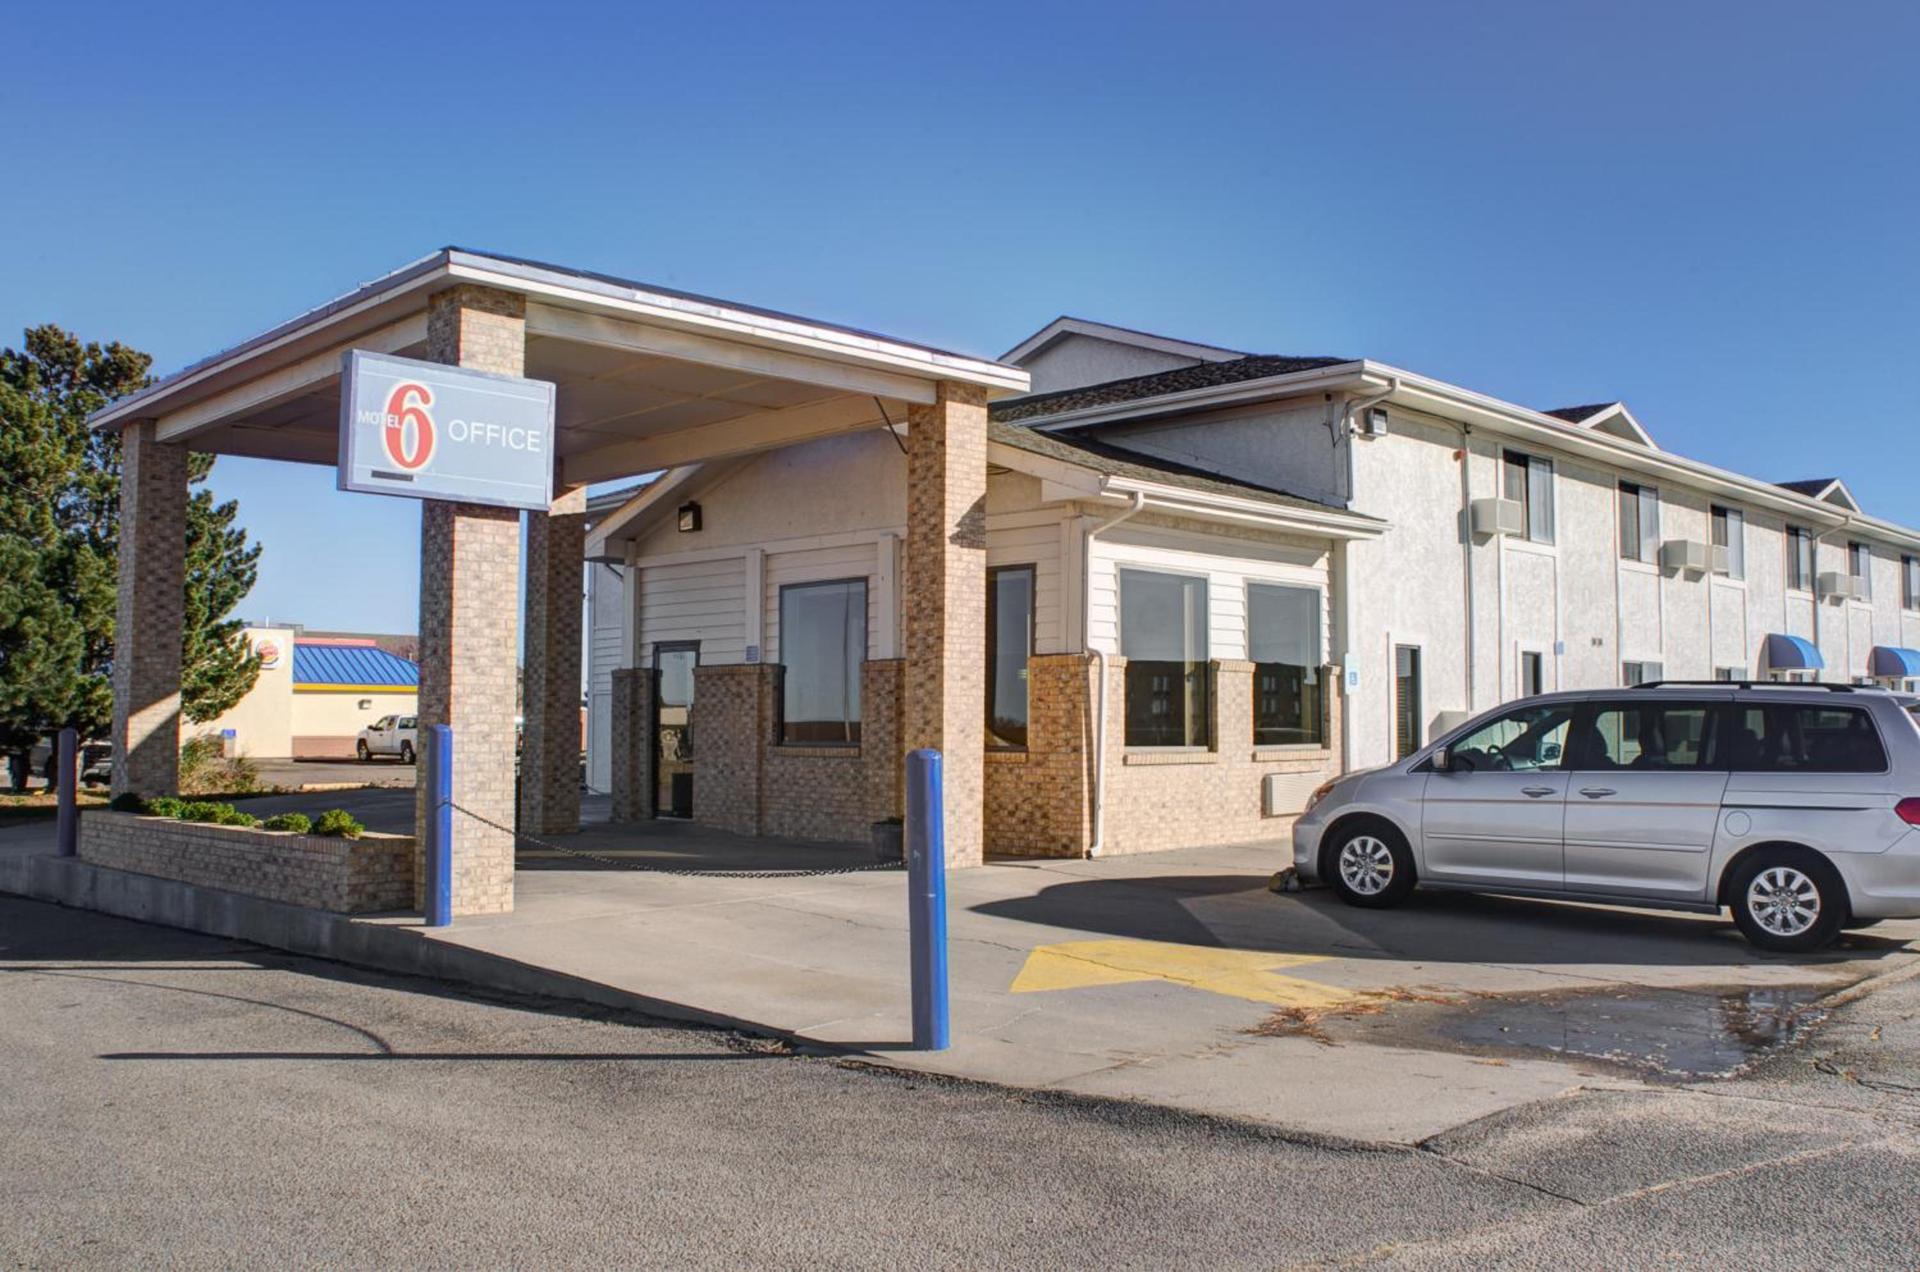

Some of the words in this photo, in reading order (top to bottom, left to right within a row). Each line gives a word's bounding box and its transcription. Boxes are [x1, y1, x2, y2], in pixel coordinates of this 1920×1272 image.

[358, 410, 402, 429] MOTEL
[384, 383, 434, 470] 6
[448, 419, 541, 453] OFFICE
